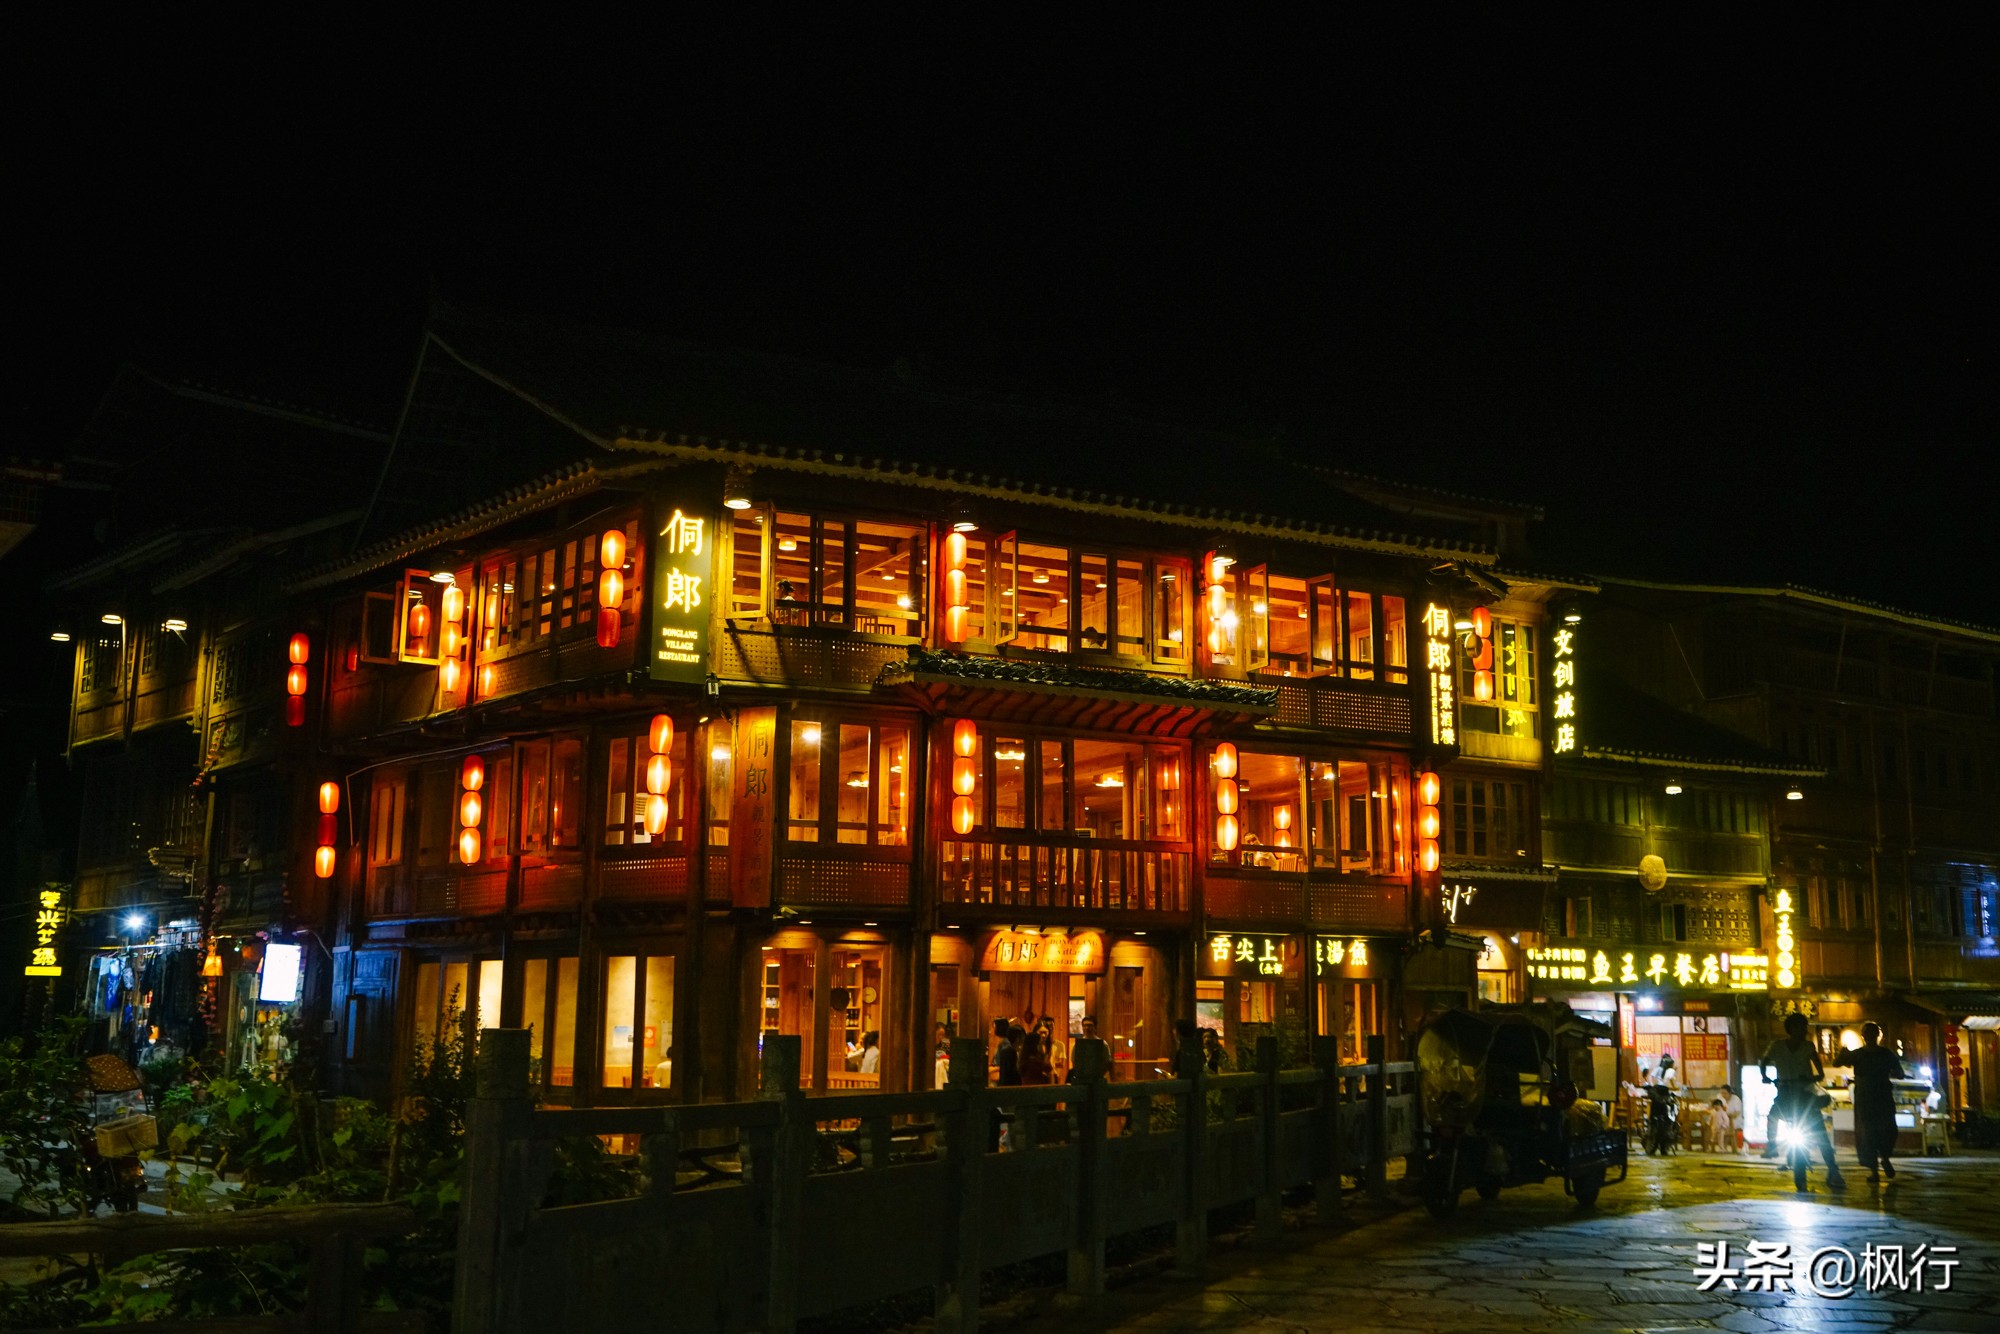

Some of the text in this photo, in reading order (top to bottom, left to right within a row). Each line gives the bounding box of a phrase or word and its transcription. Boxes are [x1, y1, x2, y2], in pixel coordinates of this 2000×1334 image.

[659, 509, 704, 614] 侗郎
[662, 627, 698, 641] DONGLANG
[1421, 602, 1452, 674] 侗郎
[665, 639, 694, 651] VILLAGE
[658, 650, 700, 664] RESTAURANT
[988, 937, 1039, 964] 侗郎
